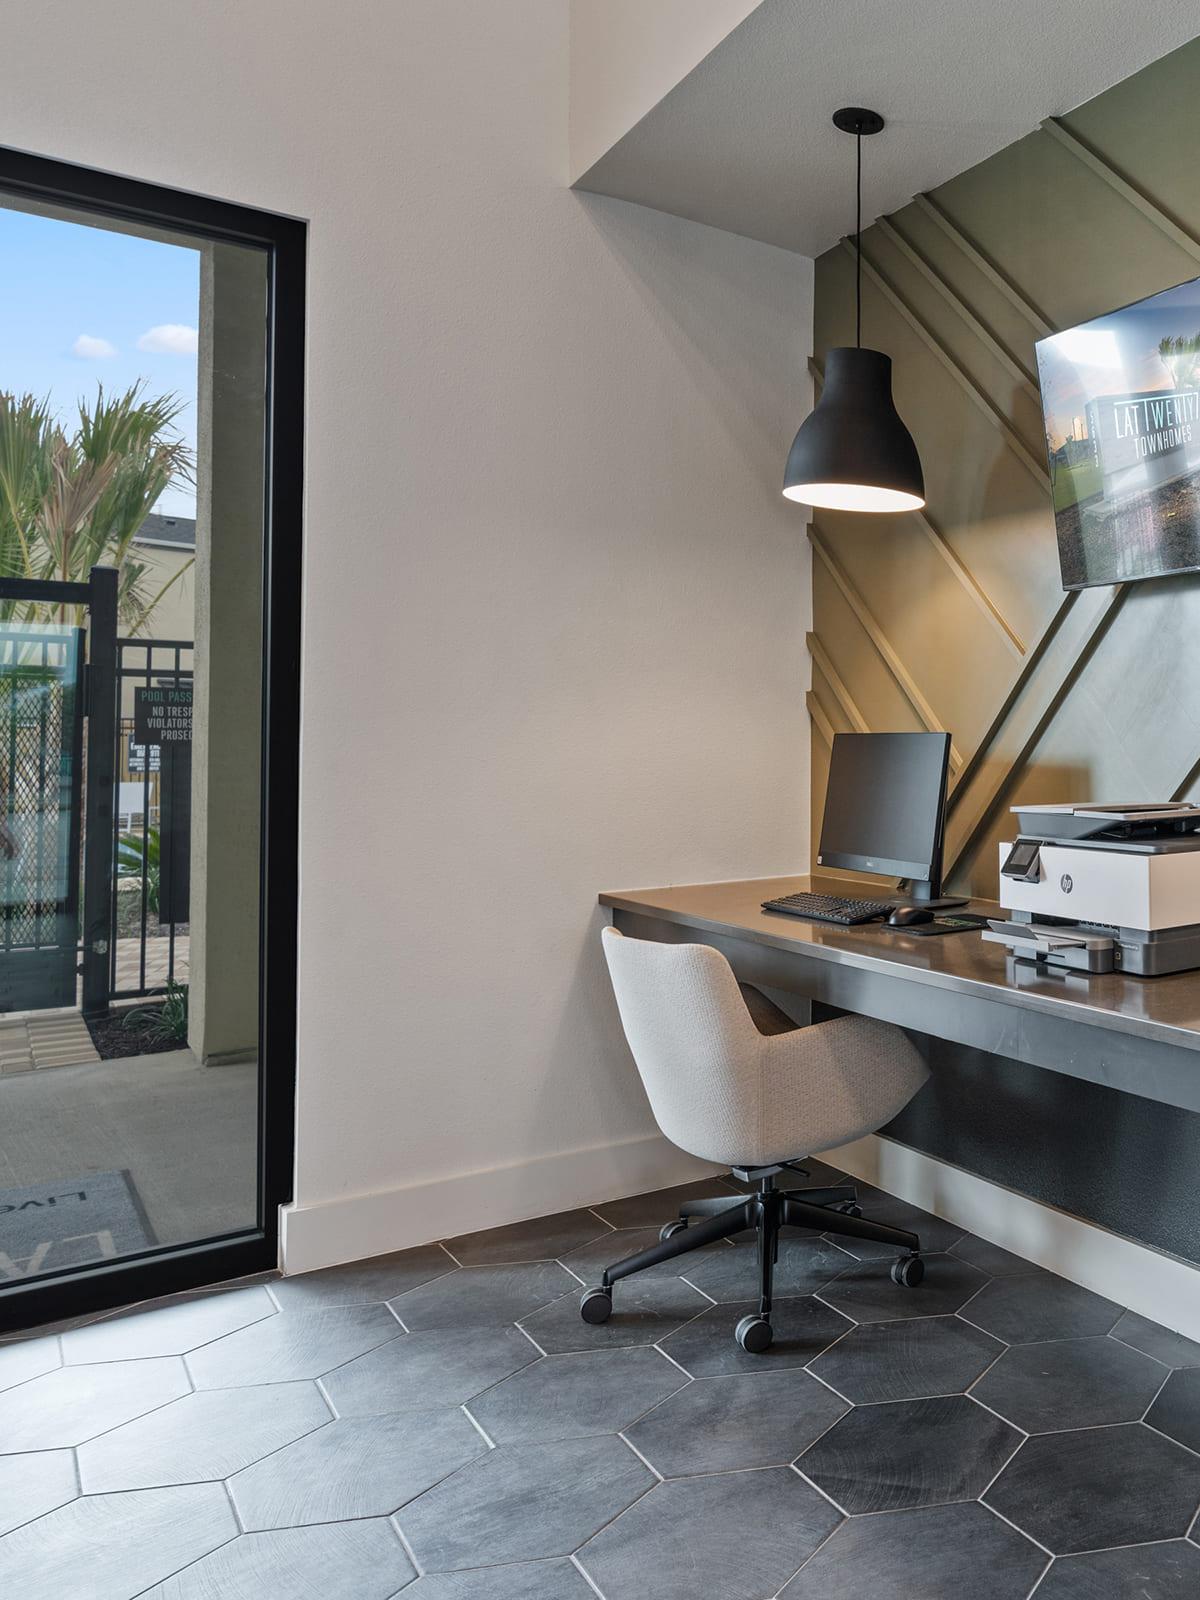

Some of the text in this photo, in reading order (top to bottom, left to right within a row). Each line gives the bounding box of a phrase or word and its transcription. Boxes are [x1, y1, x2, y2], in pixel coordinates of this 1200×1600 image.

[1113, 405, 1140, 439] LAT
[1134, 424, 1192, 460] TOWNHOMES
[141, 690, 165, 702] POOL
[152, 706, 164, 717] NO
[147, 717, 193, 729] VIOLATORS
[1061, 873, 1073, 893] hp
